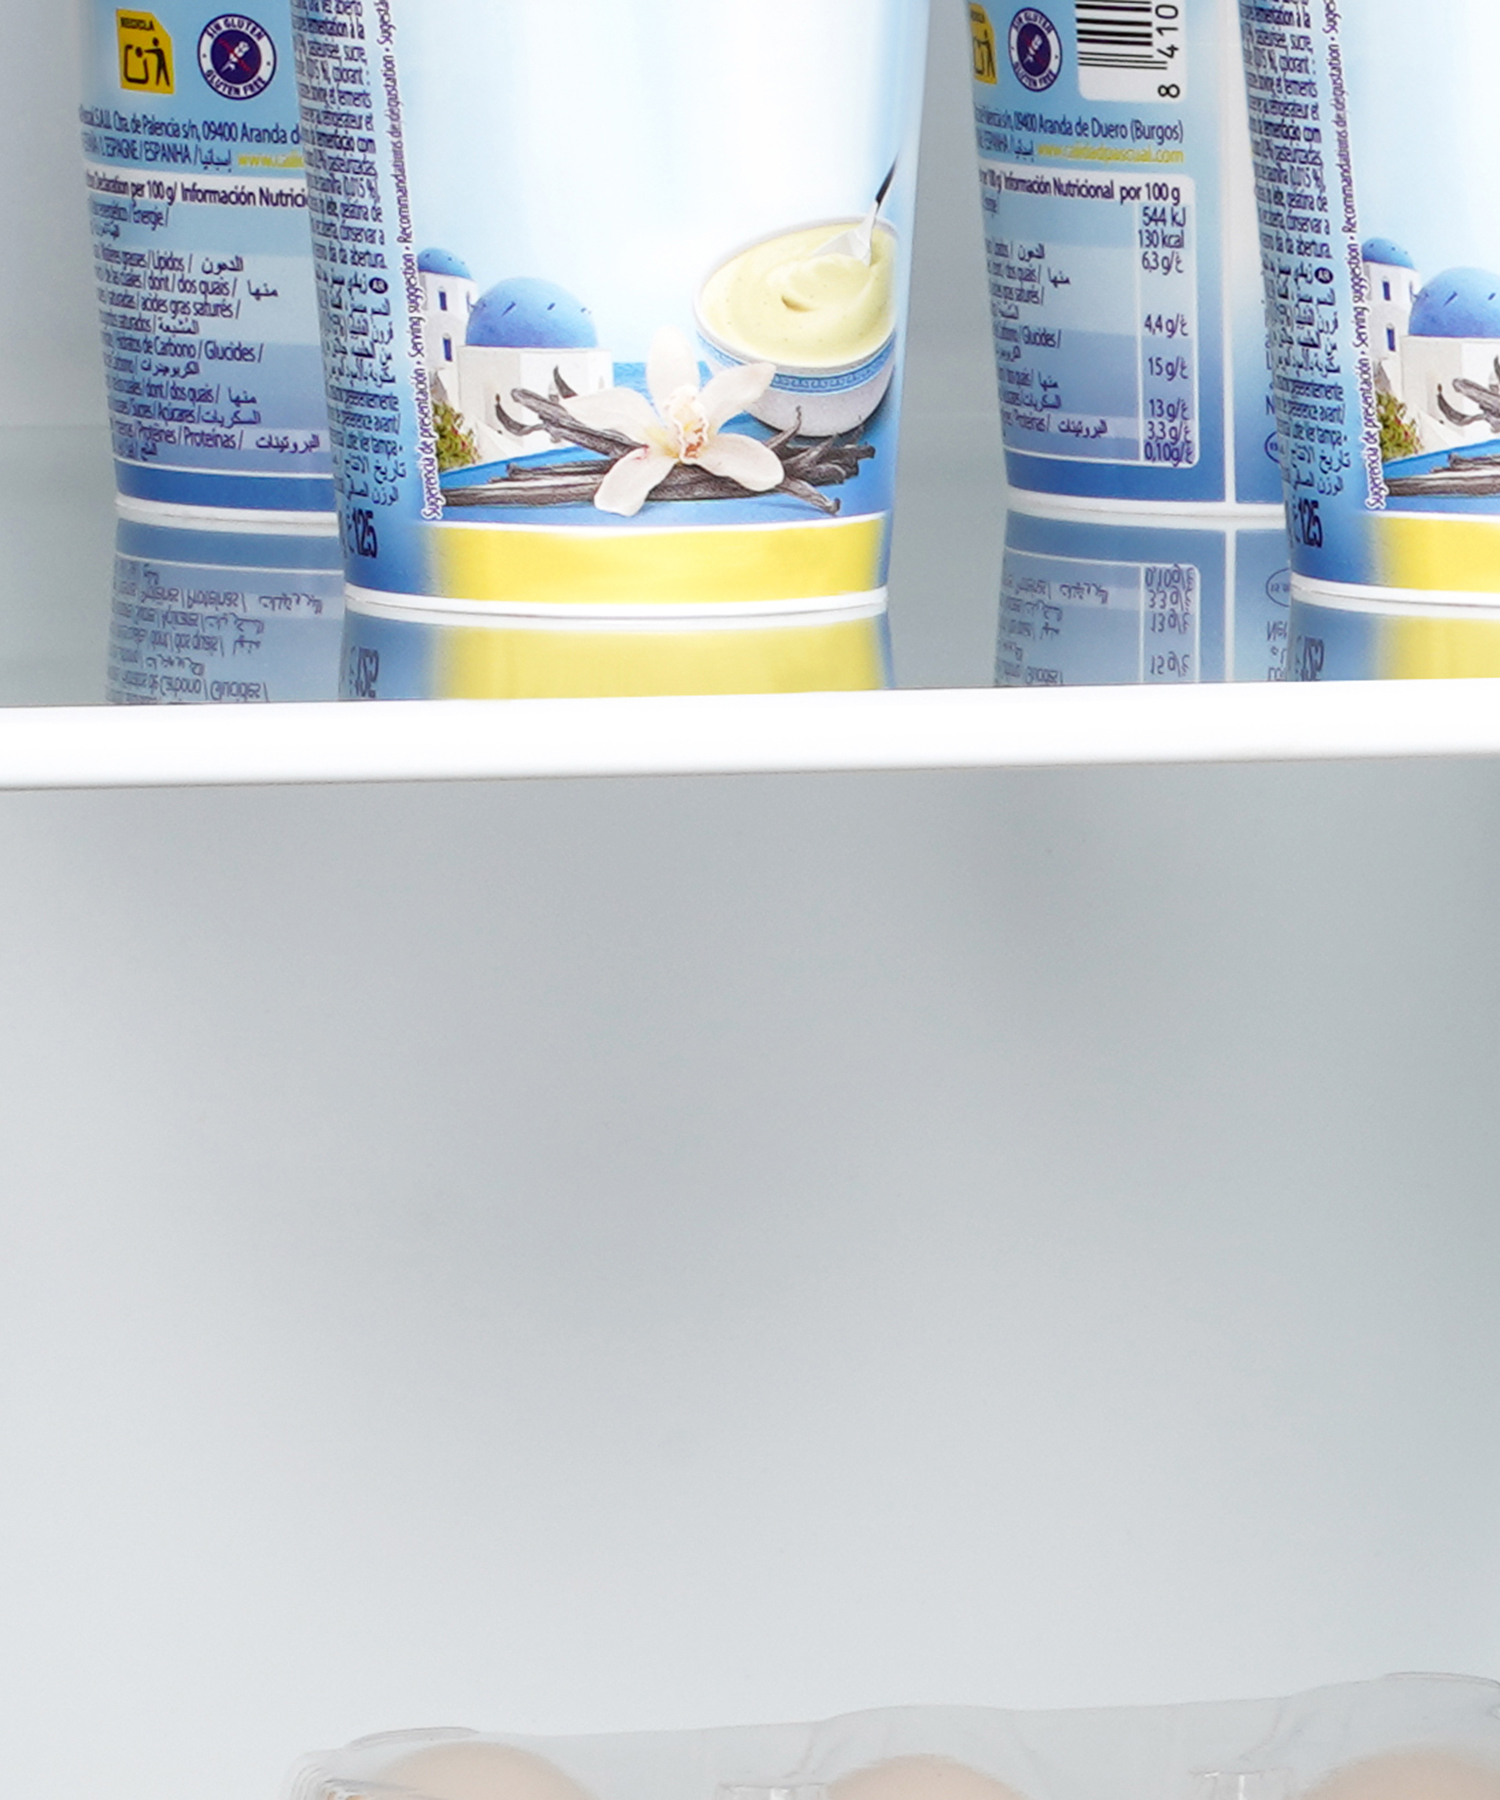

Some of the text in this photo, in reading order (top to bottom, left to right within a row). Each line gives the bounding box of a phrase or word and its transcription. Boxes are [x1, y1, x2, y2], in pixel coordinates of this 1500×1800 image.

[202, 121, 239, 143] 09400
[240, 124, 288, 145] Aranda
[1074, 116, 1090, 138] de
[1091, 117, 1128, 140] Duero
[1130, 119, 1184, 145] (Burgos)
[147, 181, 164, 199] 100
[180, 181, 254, 206] Información
[1053, 176, 1114, 200] Nutricional
[1119, 184, 1142, 205] por
[1144, 182, 1169, 202] 100
[1142, 206, 1167, 228] 544
[1138, 228, 1185, 250] 130 kcal
[402, 253, 421, 314] suggestion
[1346, 243, 1366, 304] suggestion
[405, 316, 423, 358] Serving
[1144, 314, 1164, 336] 4,4
[1349, 306, 1368, 348] Serving
[204, 338, 257, 363] Glucides
[1147, 356, 1164, 377] 15
[412, 367, 433, 440] presentación
[1356, 357, 1378, 430] presentación
[1148, 398, 1165, 419] 13
[419, 440, 430, 456] de
[1364, 430, 1375, 446] de
[419, 457, 440, 519] Sugerencia
[1364, 447, 1385, 509] Sugerencia
